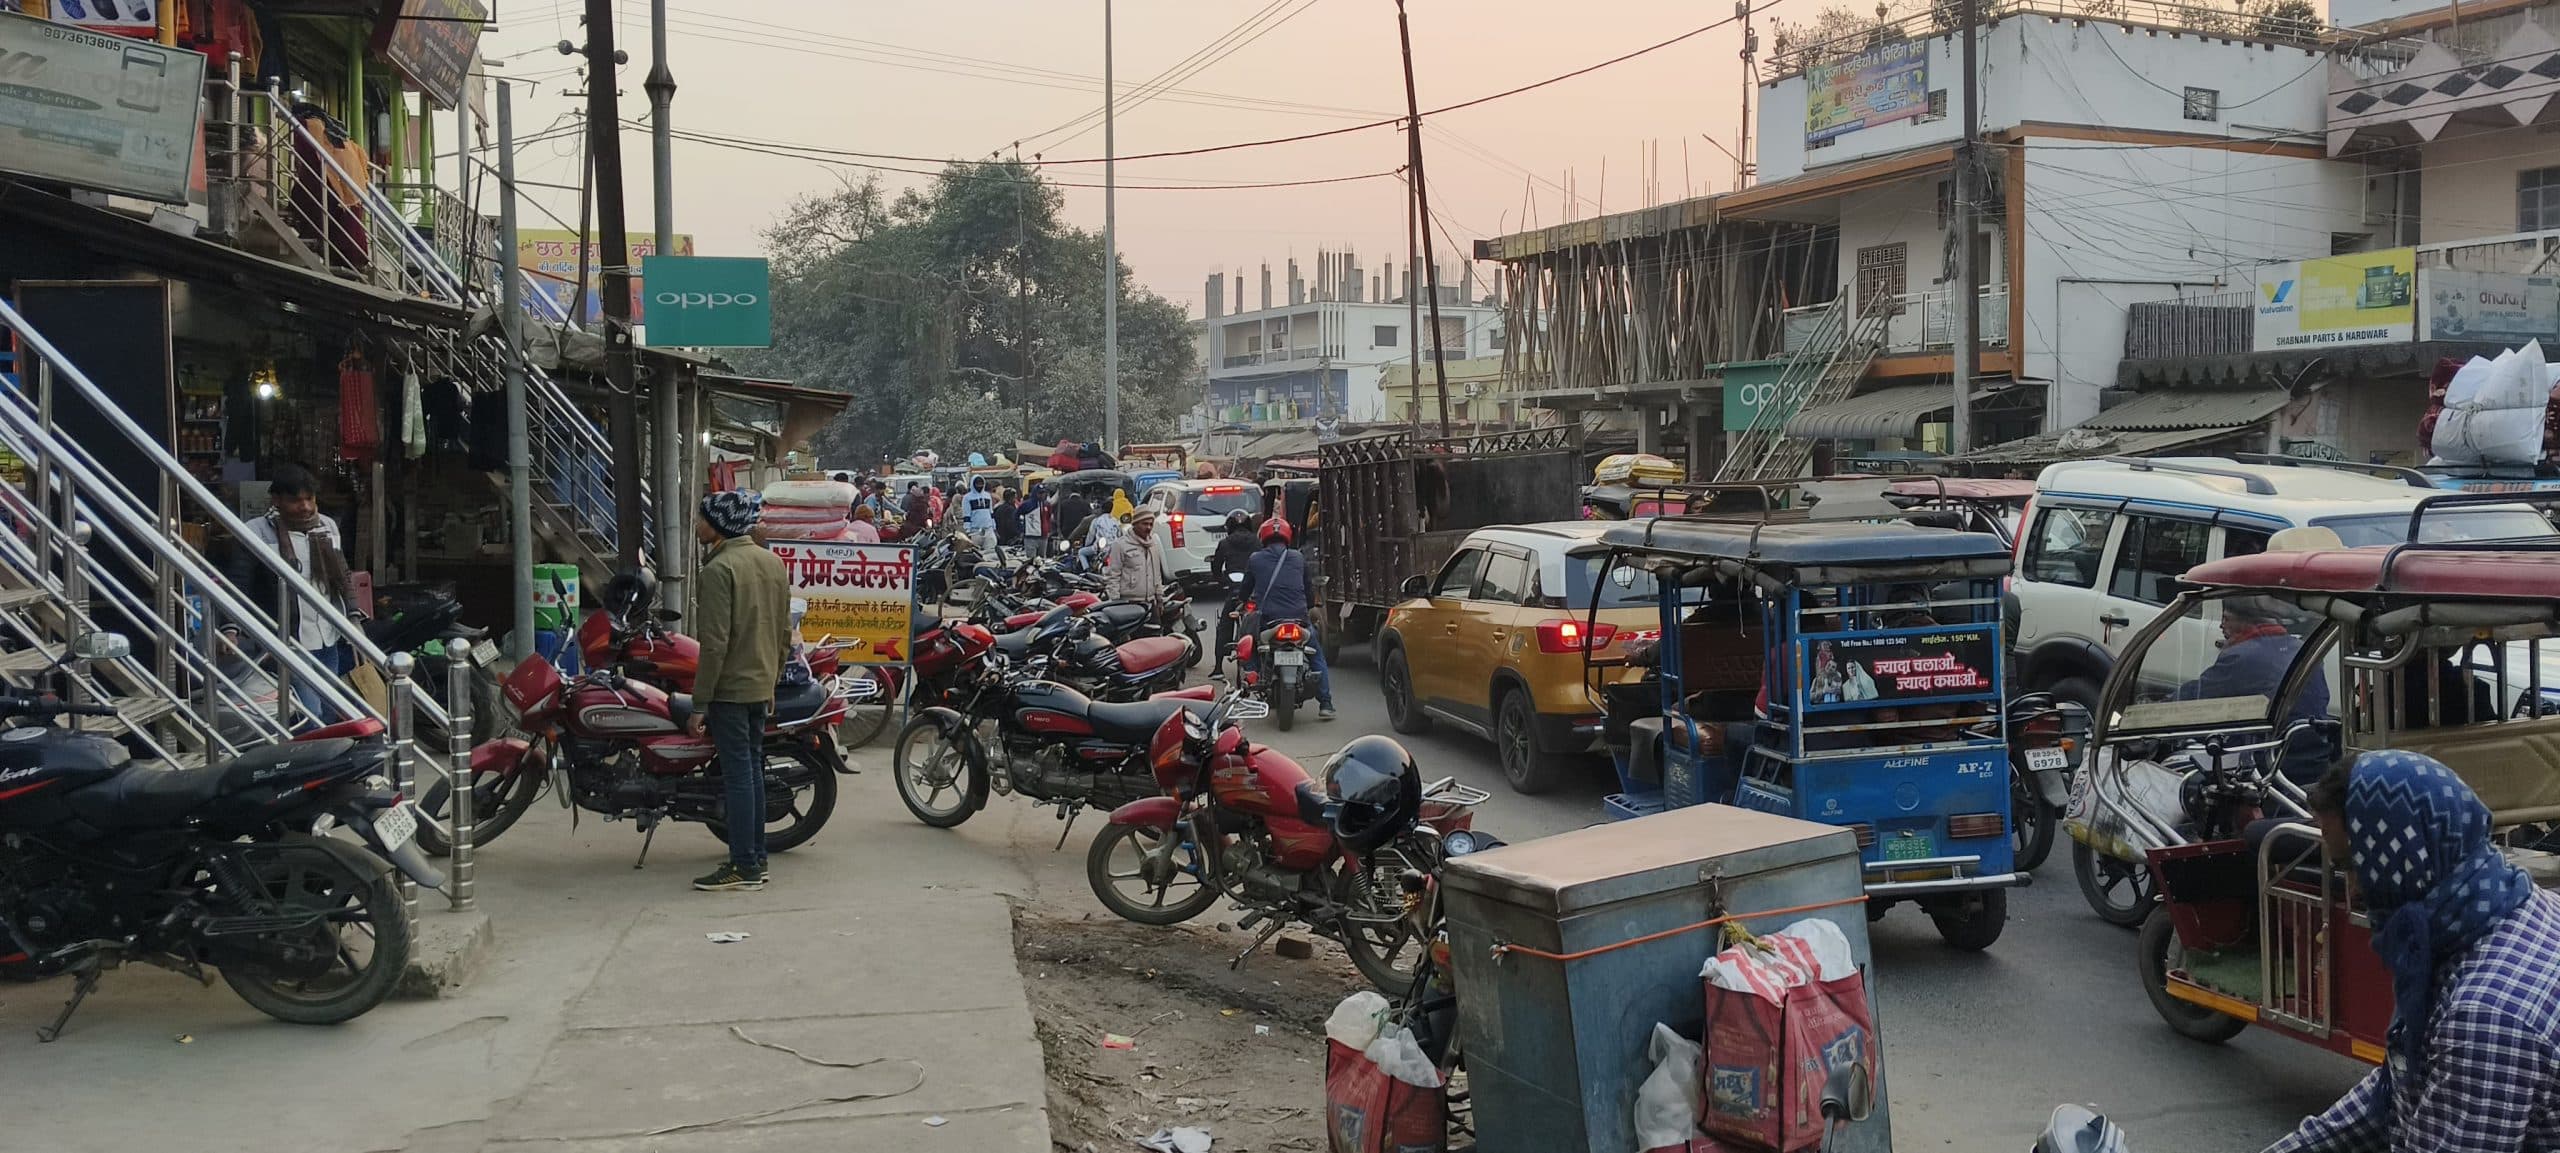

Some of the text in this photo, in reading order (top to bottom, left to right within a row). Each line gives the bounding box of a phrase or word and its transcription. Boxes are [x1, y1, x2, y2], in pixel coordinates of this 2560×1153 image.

[2276, 328, 2389, 346] SHABNAM PARTS & HARDWARE
[798, 548, 836, 589] प्रेम
[2033, 757, 2062, 768] 6978
